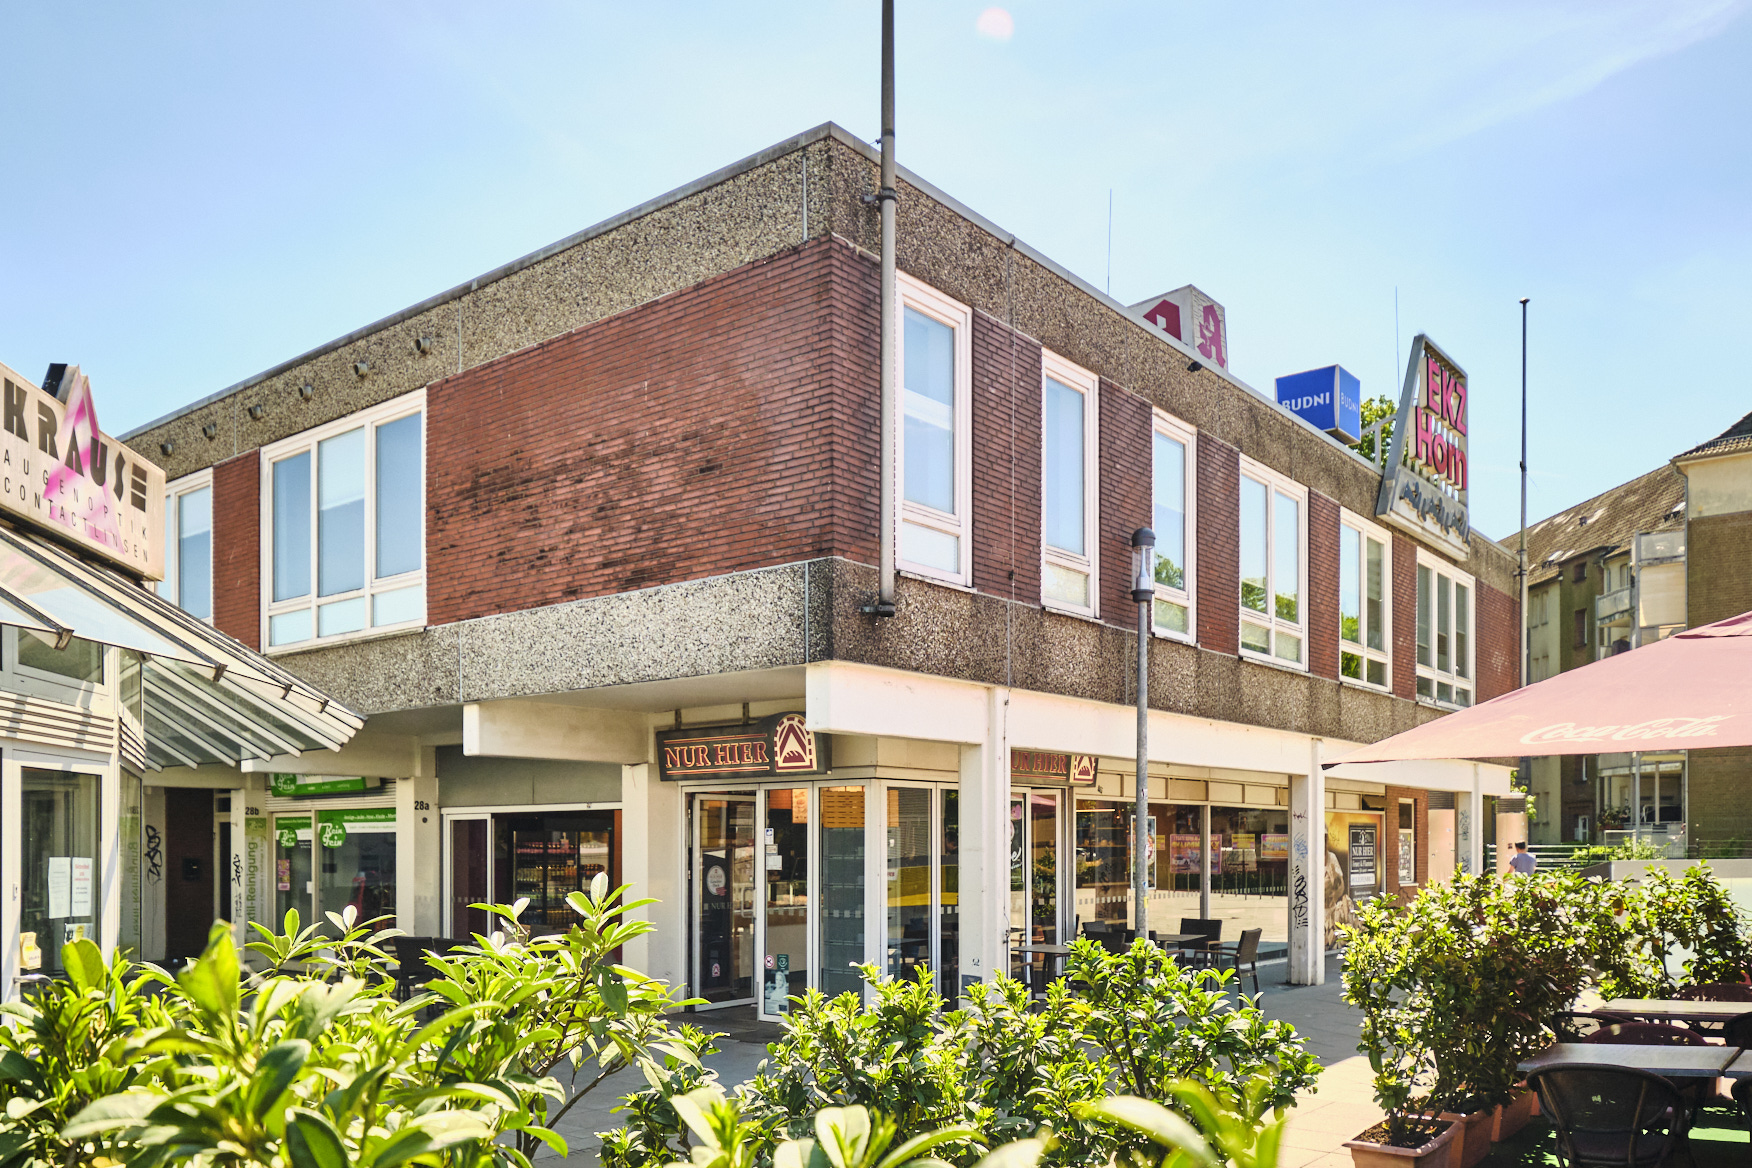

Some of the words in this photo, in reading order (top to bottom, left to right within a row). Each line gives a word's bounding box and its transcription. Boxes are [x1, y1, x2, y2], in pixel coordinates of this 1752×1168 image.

[1281, 391, 1330, 411] BUDNI
[1340, 392, 1359, 415] BUDNI
[1426, 355, 1467, 437] EKZ
[3, 376, 148, 514] KRAUSE
[1415, 405, 1467, 490] Horn
[3, 448, 148, 541] AUGENOPTIK
[3, 476, 149, 563] CONTACTLINSEN
[1519, 714, 1737, 745] Coca-Cola
[664, 744, 711, 768] NUR
[713, 741, 770, 766] HIER
[1011, 751, 1031, 771] UR
[1032, 752, 1067, 774] HIER
[245, 807, 259, 815] 28b
[414, 801, 430, 811] 28a
[321, 823, 343, 836] Rein
